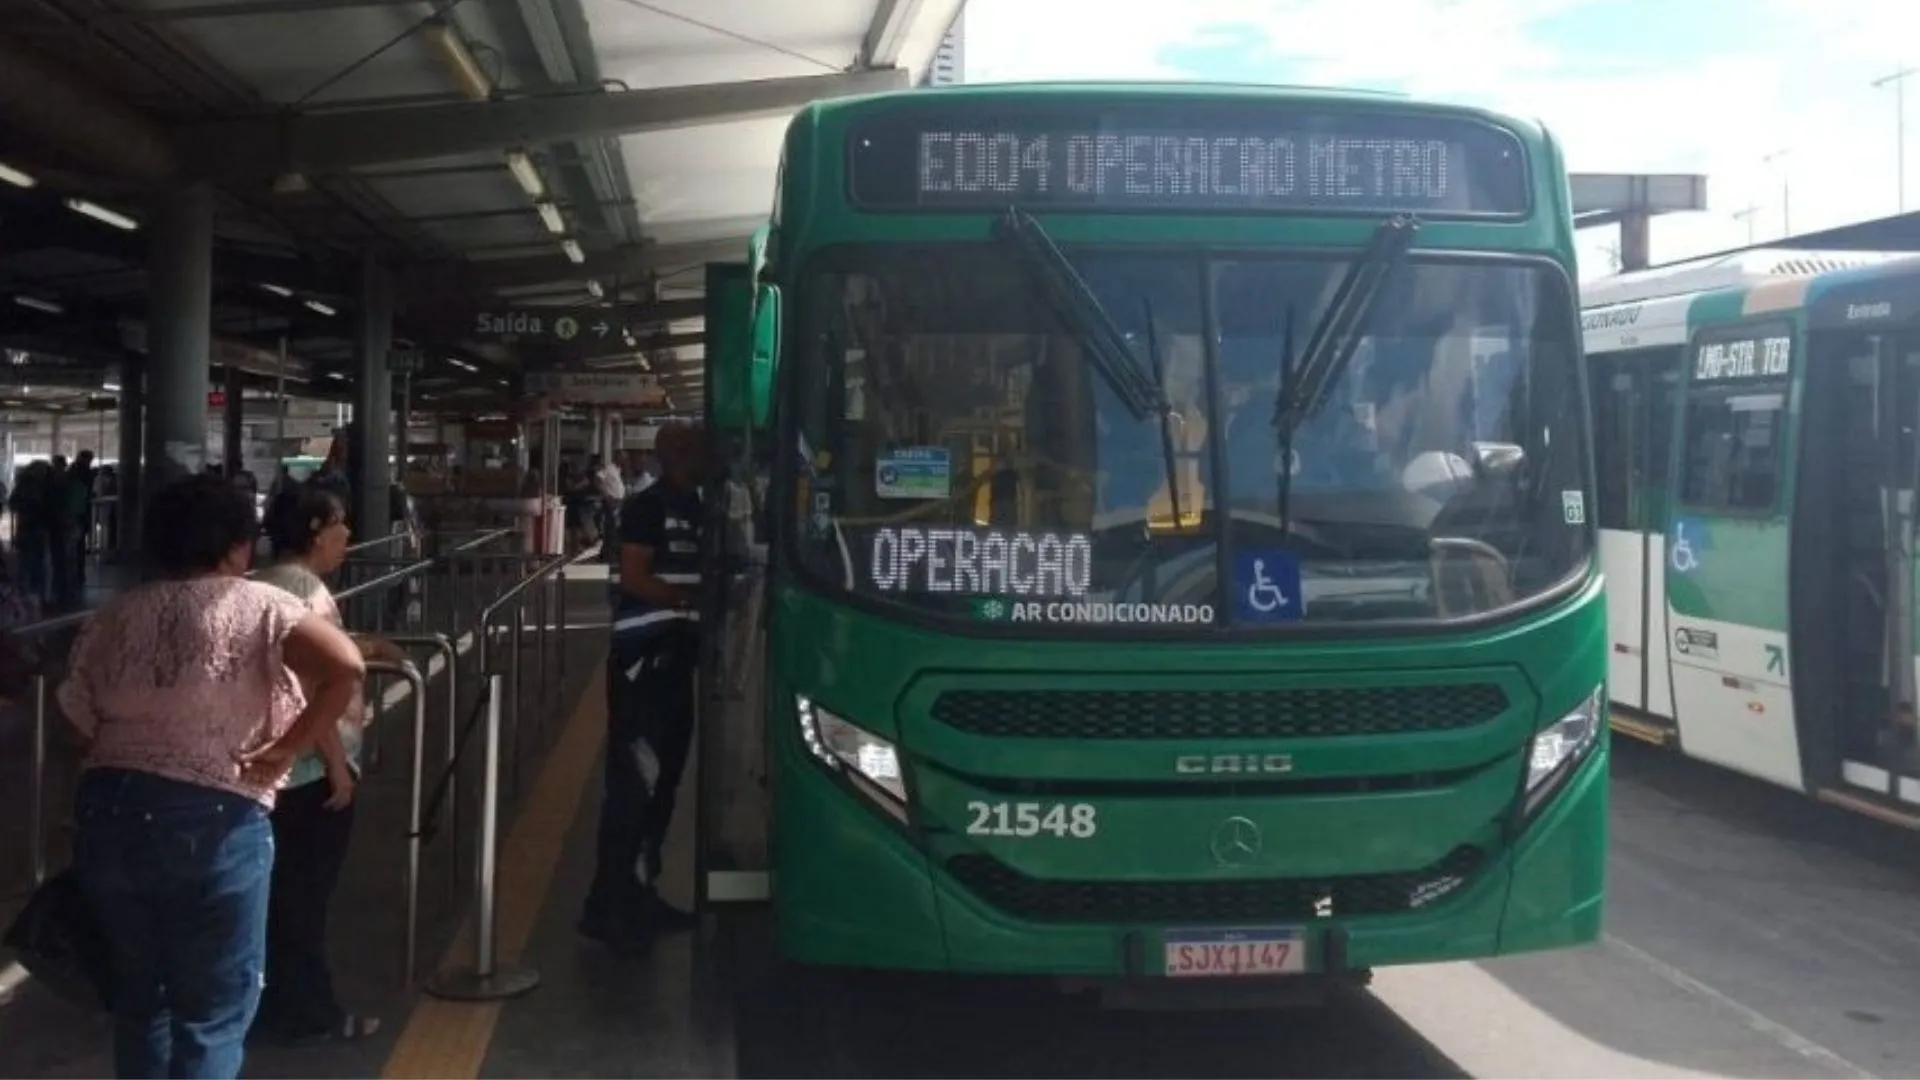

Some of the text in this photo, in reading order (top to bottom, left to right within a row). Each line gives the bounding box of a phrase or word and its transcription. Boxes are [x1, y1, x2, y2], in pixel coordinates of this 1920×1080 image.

[1067, 134, 1294, 195] OPERACAO
[1309, 137, 1447, 198] METRO
[475, 311, 543, 334] Saída
[871, 528, 1091, 596] OPERACAO
[1011, 602, 1214, 624] AR CONDICIONADO
[966, 800, 1097, 838] 21548
